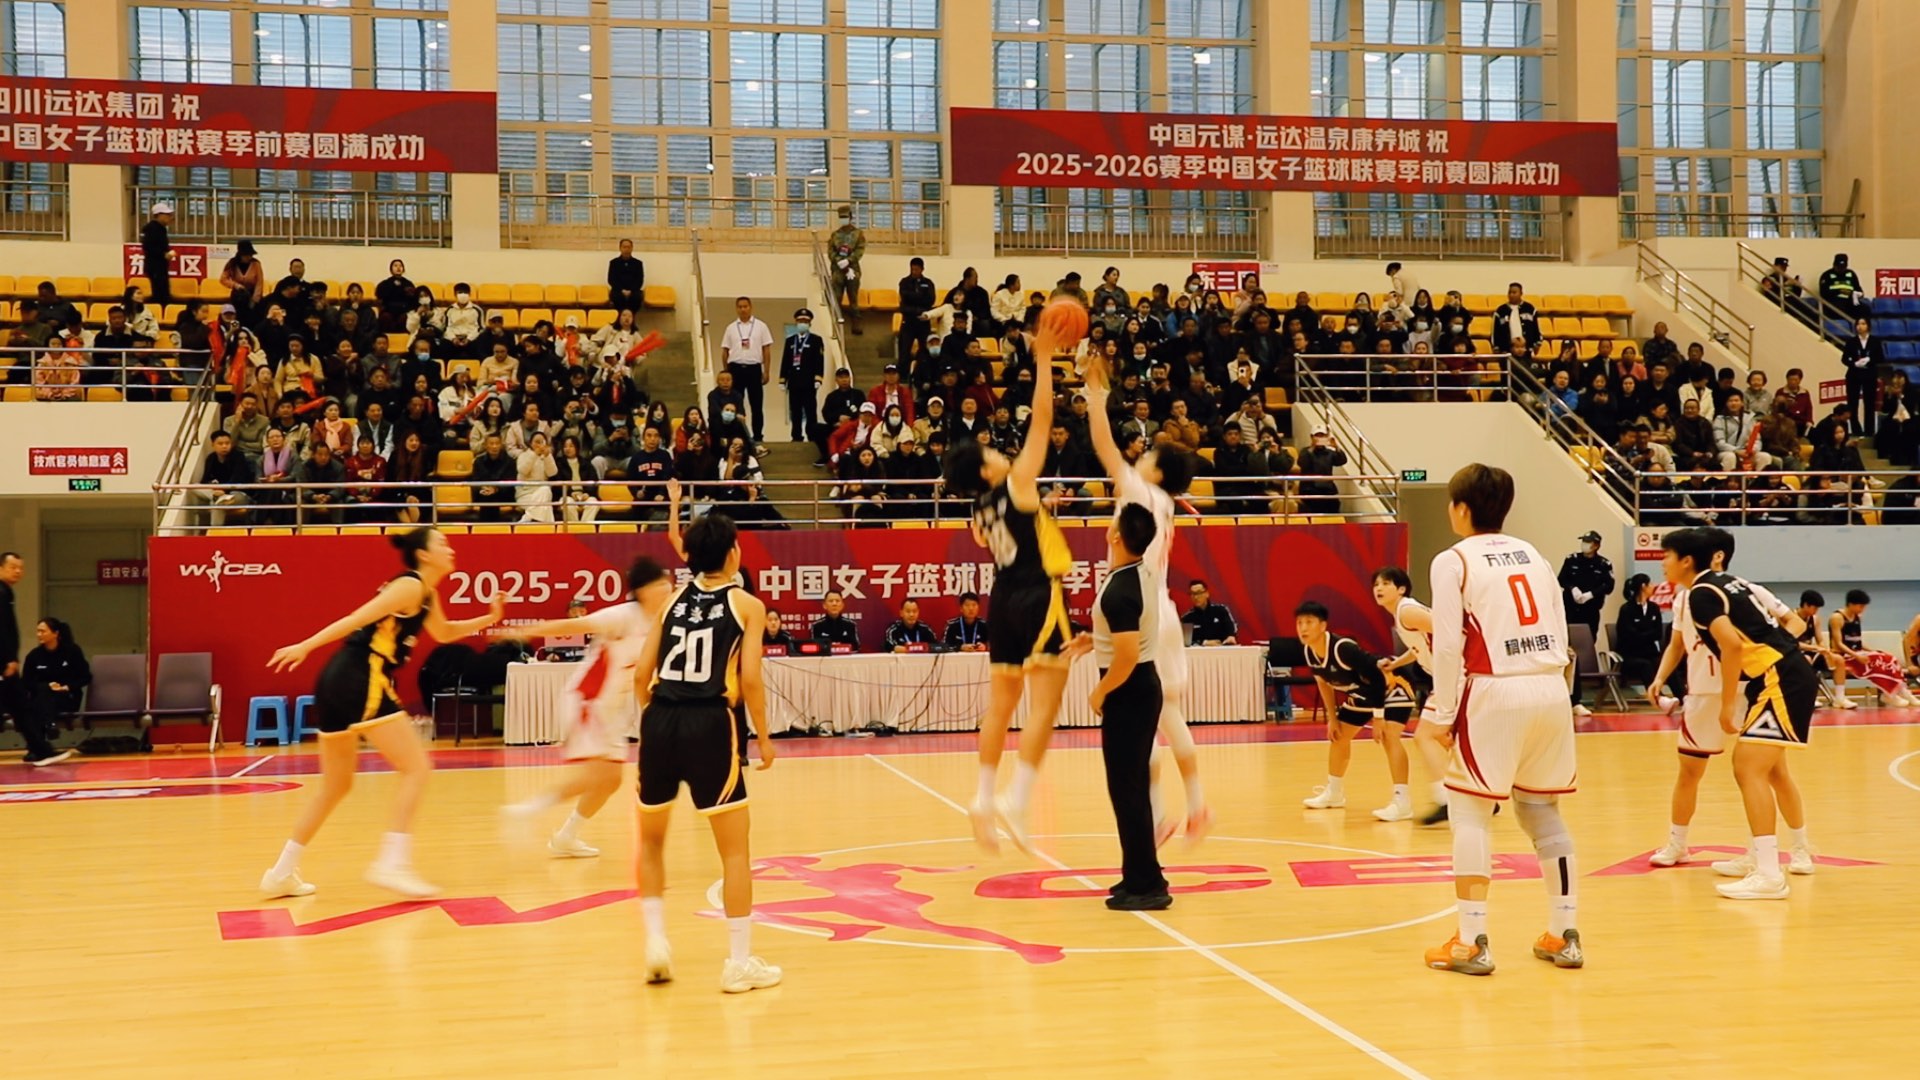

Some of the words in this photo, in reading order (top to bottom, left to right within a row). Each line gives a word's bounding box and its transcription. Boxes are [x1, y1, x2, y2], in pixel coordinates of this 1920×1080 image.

[171, 94, 200, 121] 祝
[1149, 123, 1420, 153] 中国元谋·远达温泉康养城
[1426, 129, 1449, 153] 祝
[1016, 152, 1560, 186] 2025-2026赛季中国女子篮球联赛季前赛圆满成功
[1879, 277, 1920, 295] 东四
[1507, 573, 1539, 627] 0
[658, 625, 714, 683] 20
